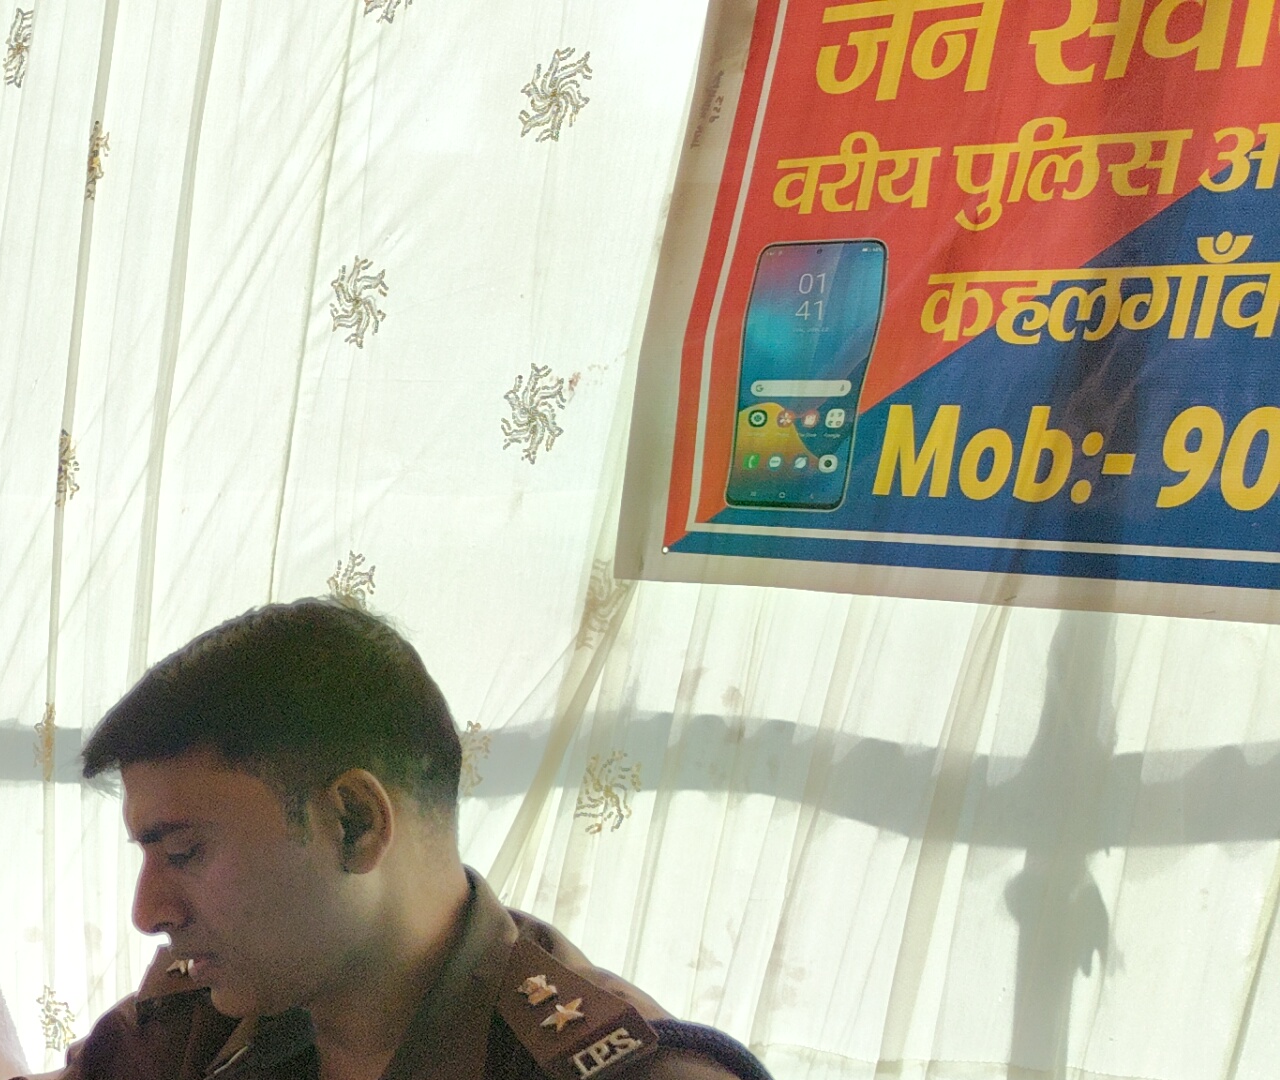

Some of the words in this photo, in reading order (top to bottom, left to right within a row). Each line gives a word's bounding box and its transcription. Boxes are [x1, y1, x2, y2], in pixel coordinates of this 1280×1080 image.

[816, 0, 1005, 101] जन
[773, 131, 941, 215] वरीय
[953, 117, 1193, 231] पुलिस
[795, 300, 825, 321] 41
[798, 273, 827, 295] 01
[871, 404, 1137, 505] Mob:-
